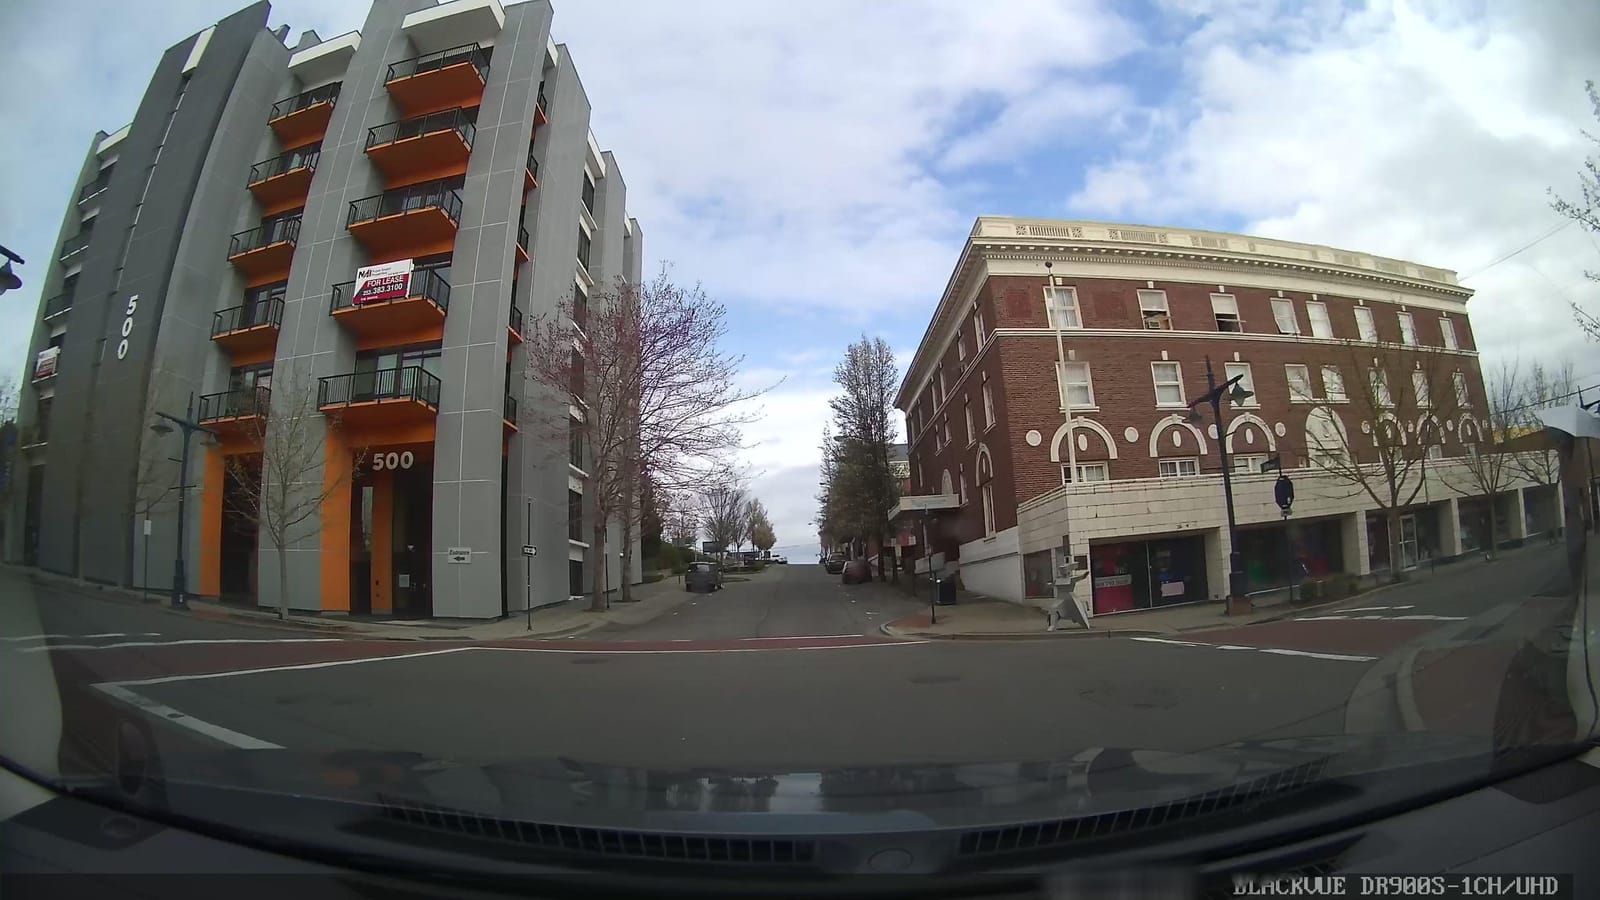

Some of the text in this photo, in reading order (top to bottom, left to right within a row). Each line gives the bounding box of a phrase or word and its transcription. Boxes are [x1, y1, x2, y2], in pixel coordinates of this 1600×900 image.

[367, 274, 404, 288] FOR LEASE
[118, 294, 139, 360] 500
[372, 451, 414, 471] 500
